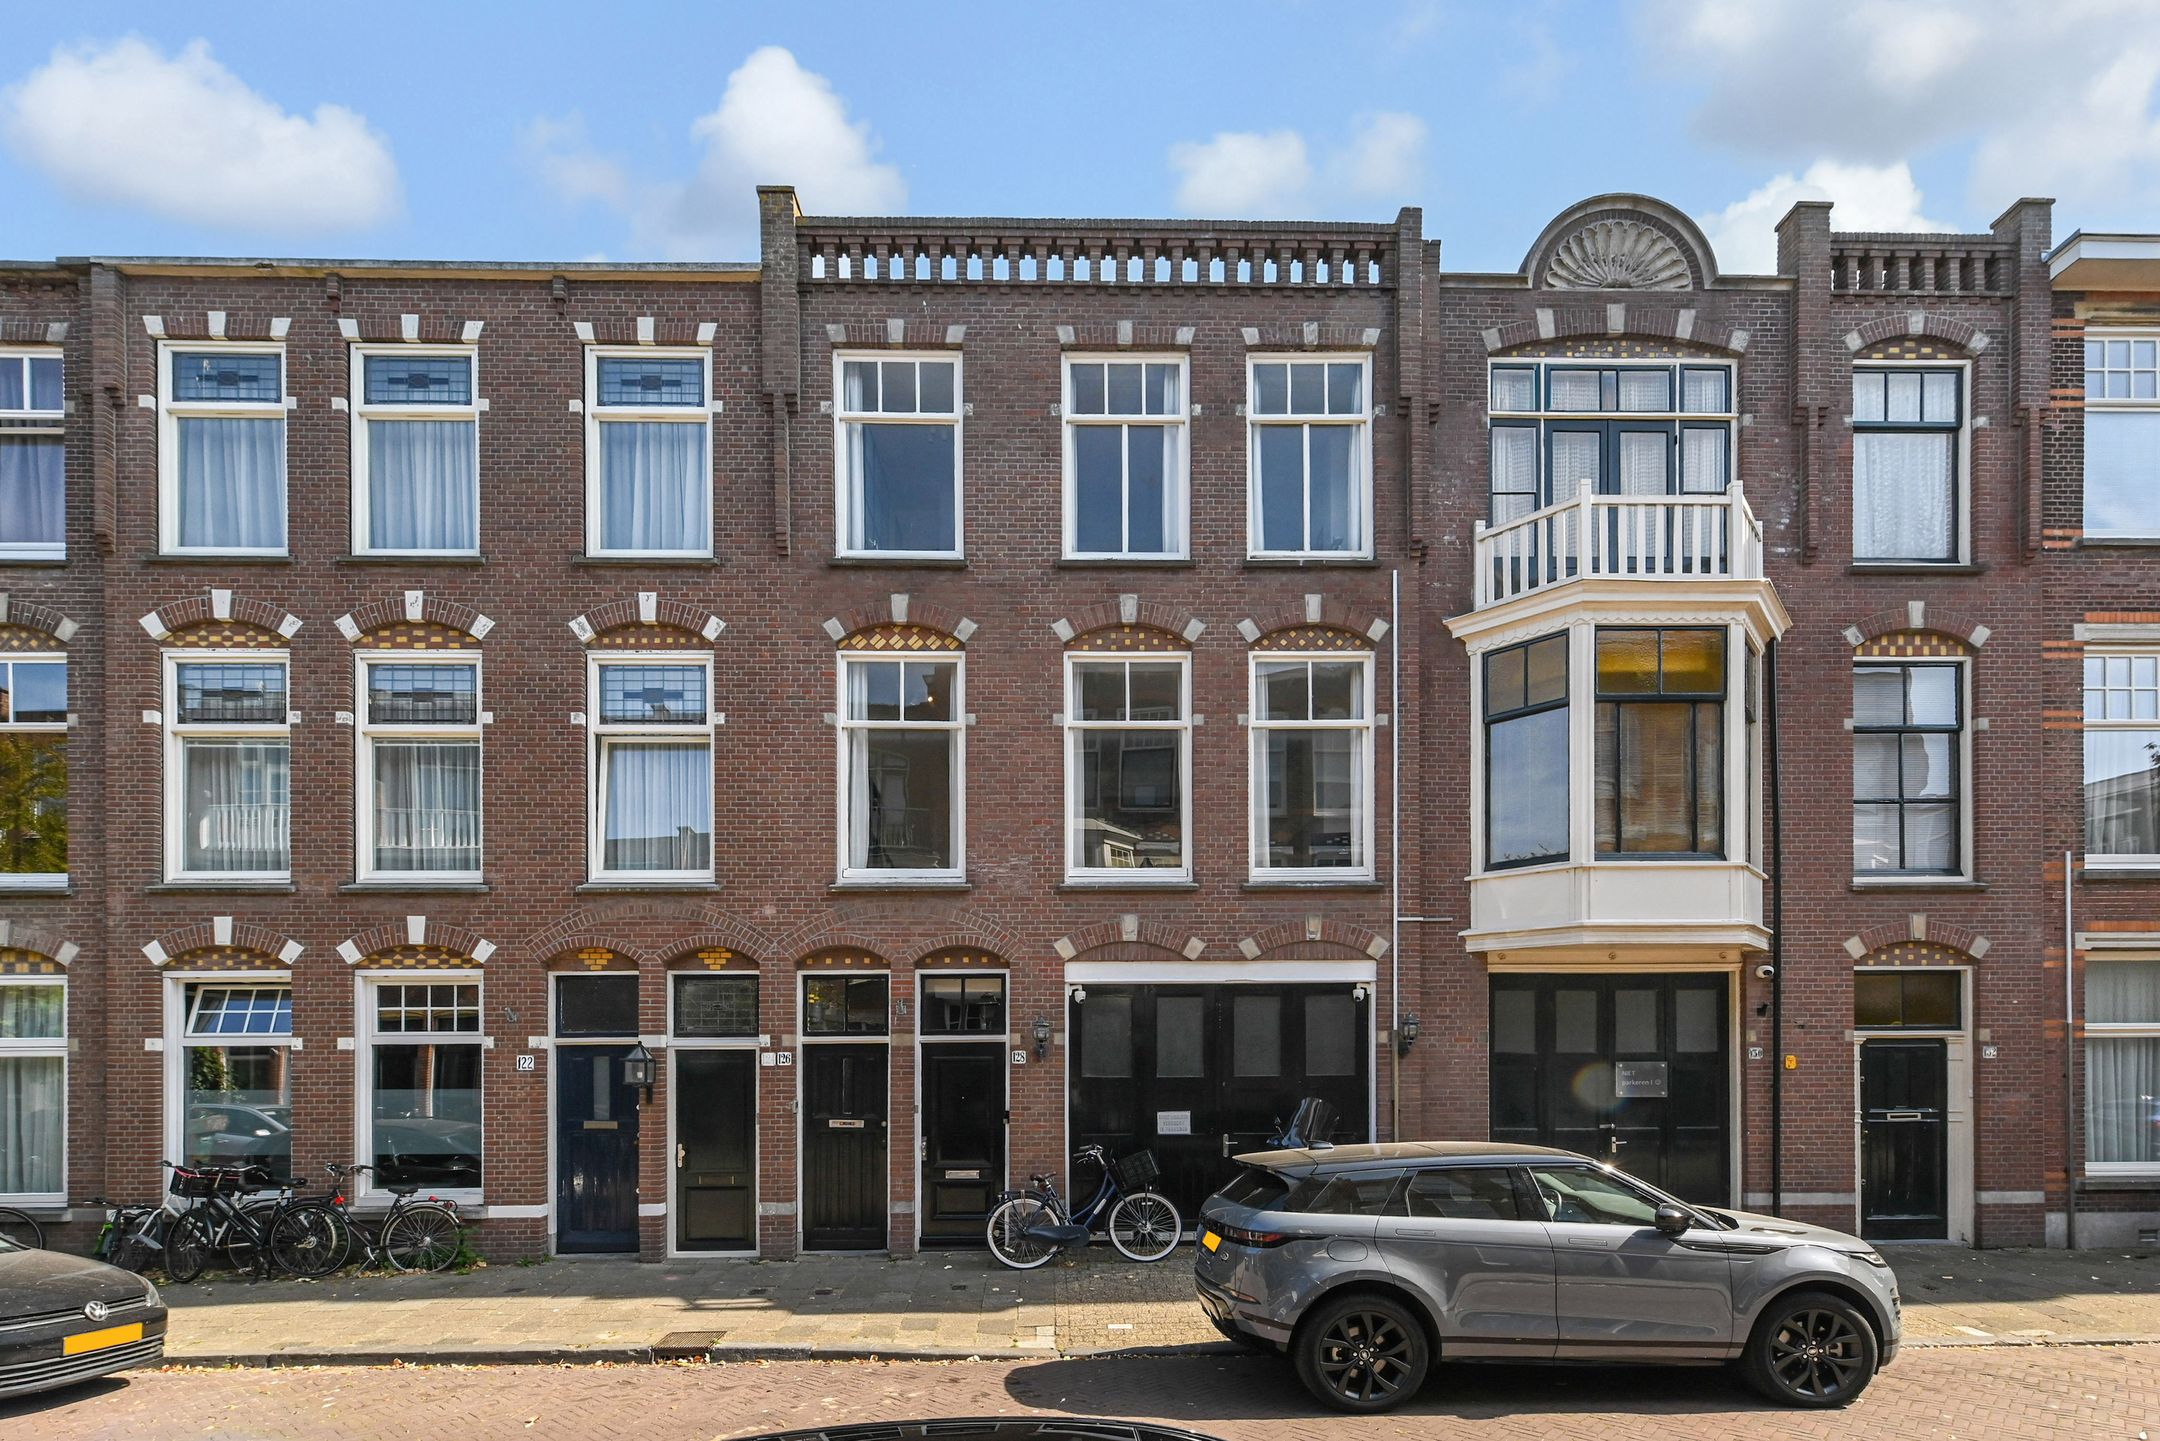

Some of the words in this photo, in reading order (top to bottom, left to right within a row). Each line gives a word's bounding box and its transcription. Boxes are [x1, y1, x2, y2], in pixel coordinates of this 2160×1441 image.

[518, 1056, 533, 1069] 122
[778, 1053, 791, 1065] 126
[1012, 1052, 1025, 1063] 128
